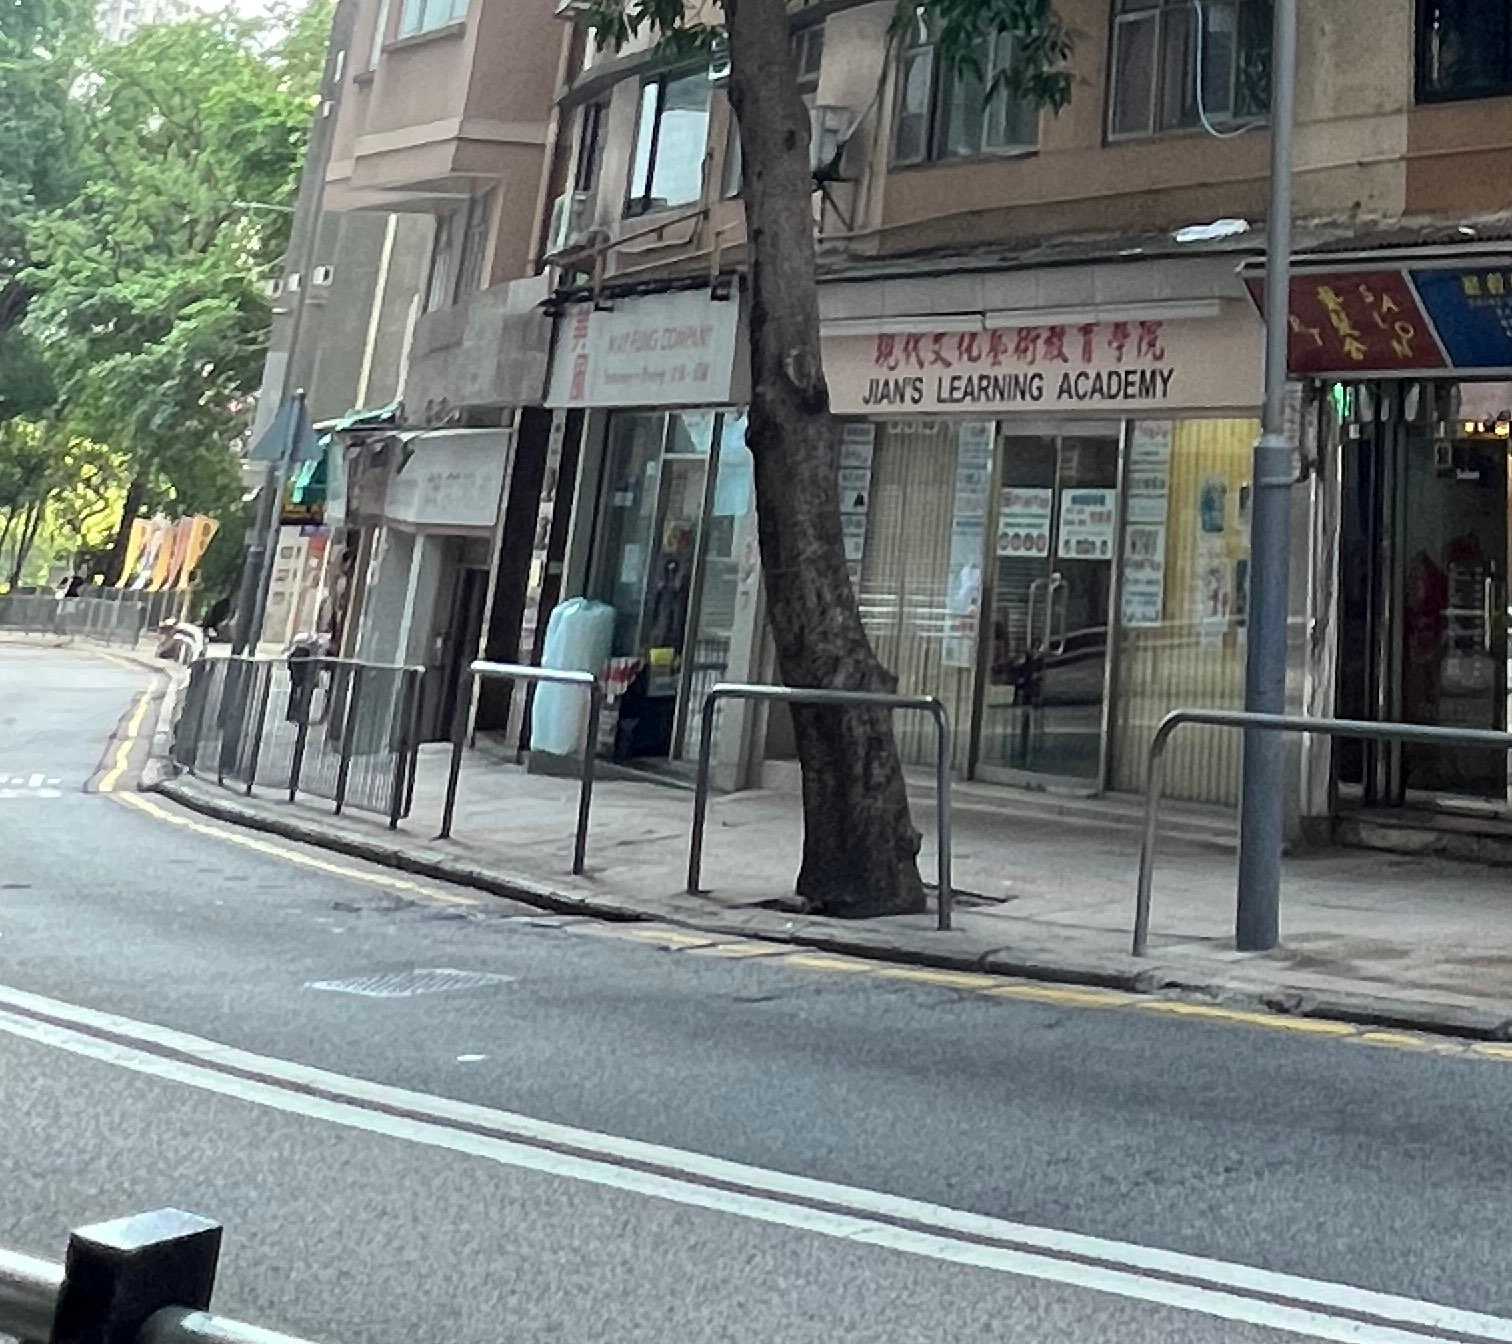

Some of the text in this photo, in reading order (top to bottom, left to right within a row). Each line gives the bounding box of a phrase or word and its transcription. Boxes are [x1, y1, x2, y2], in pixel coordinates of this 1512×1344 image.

[862, 367, 1175, 405] JIAN'S LEARNING ACADEMY
